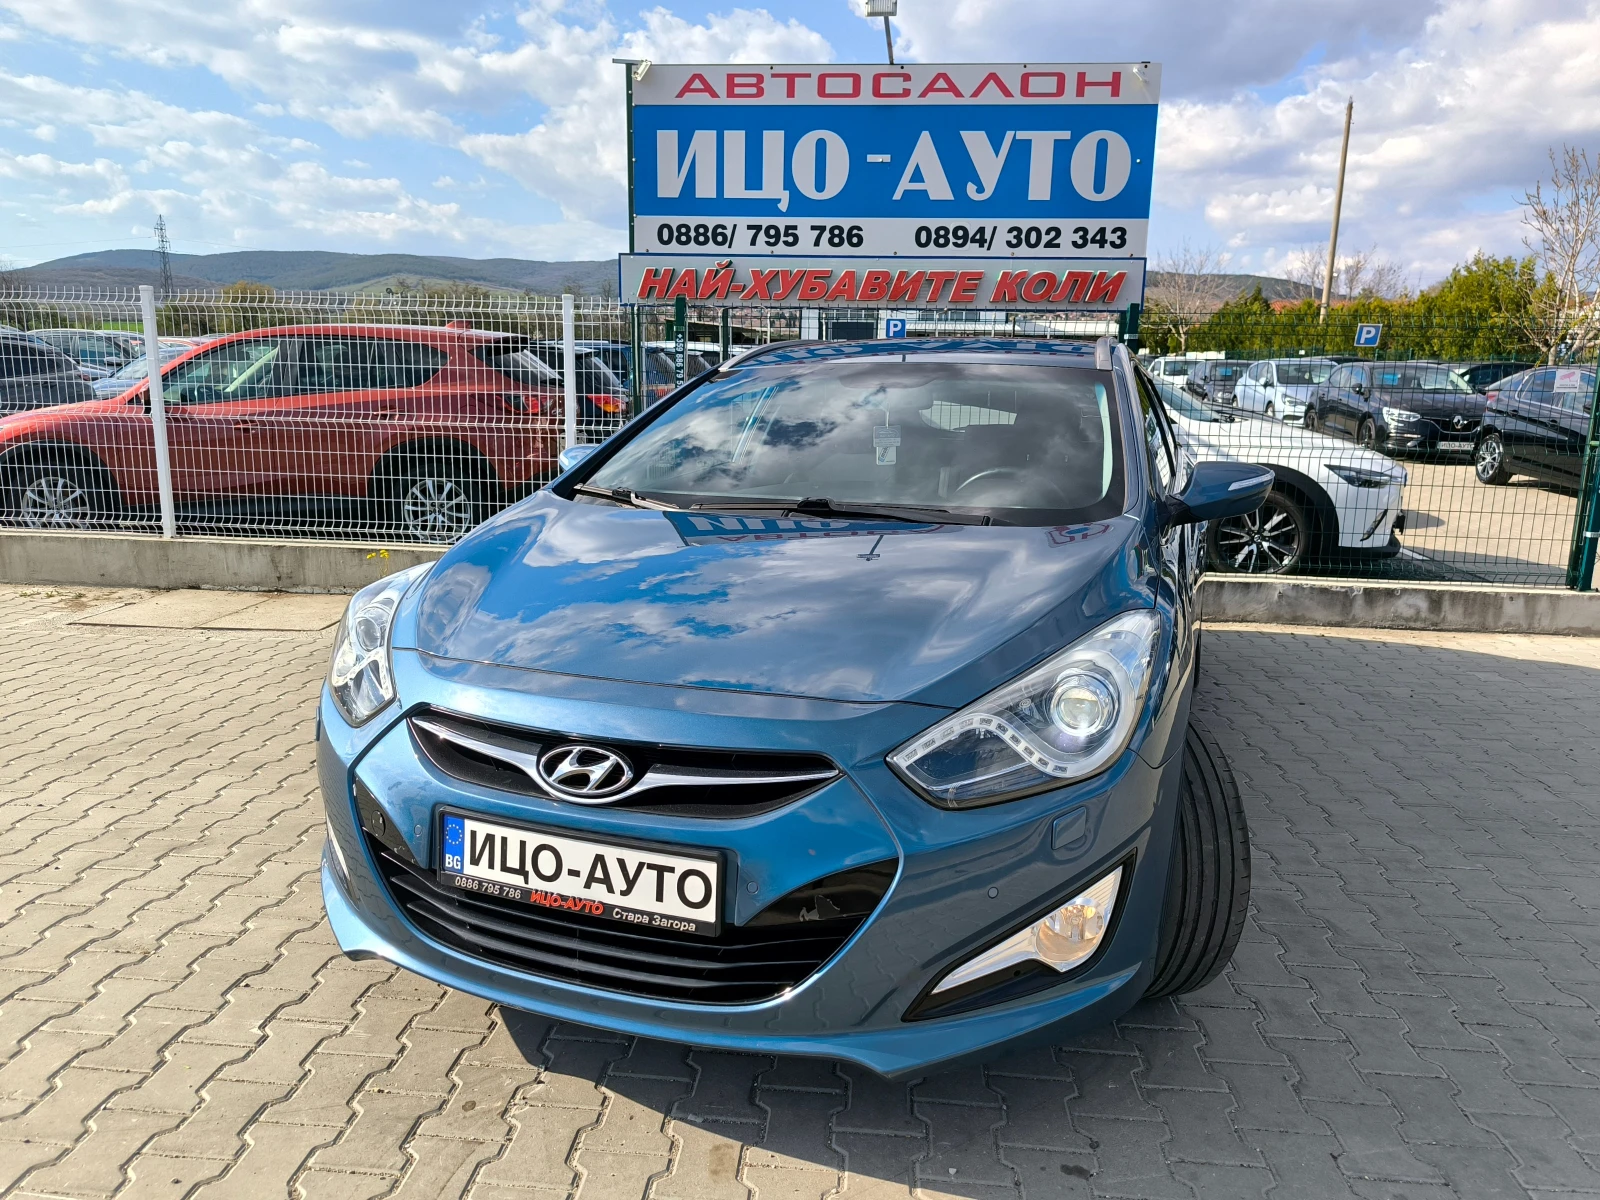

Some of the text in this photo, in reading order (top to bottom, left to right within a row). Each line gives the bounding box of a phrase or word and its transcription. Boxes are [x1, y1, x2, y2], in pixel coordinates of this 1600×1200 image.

[676, 73, 1122, 98] АВТОСАЛОН
[656, 223, 1127, 251] 0886/ 795 786 0894/ 302 343
[638, 261, 1127, 303] НАЙ-ХУБАВИТЕ КОЛИ
[889, 320, 902, 337] P
[1360, 326, 1376, 344] P
[675, 353, 684, 367] 886
[445, 853, 461, 870] BG
[469, 829, 713, 909] ИЦО-АУТО
[455, 876, 696, 932] 0886 795 786 ИЦО-АУТО Стара Загора
